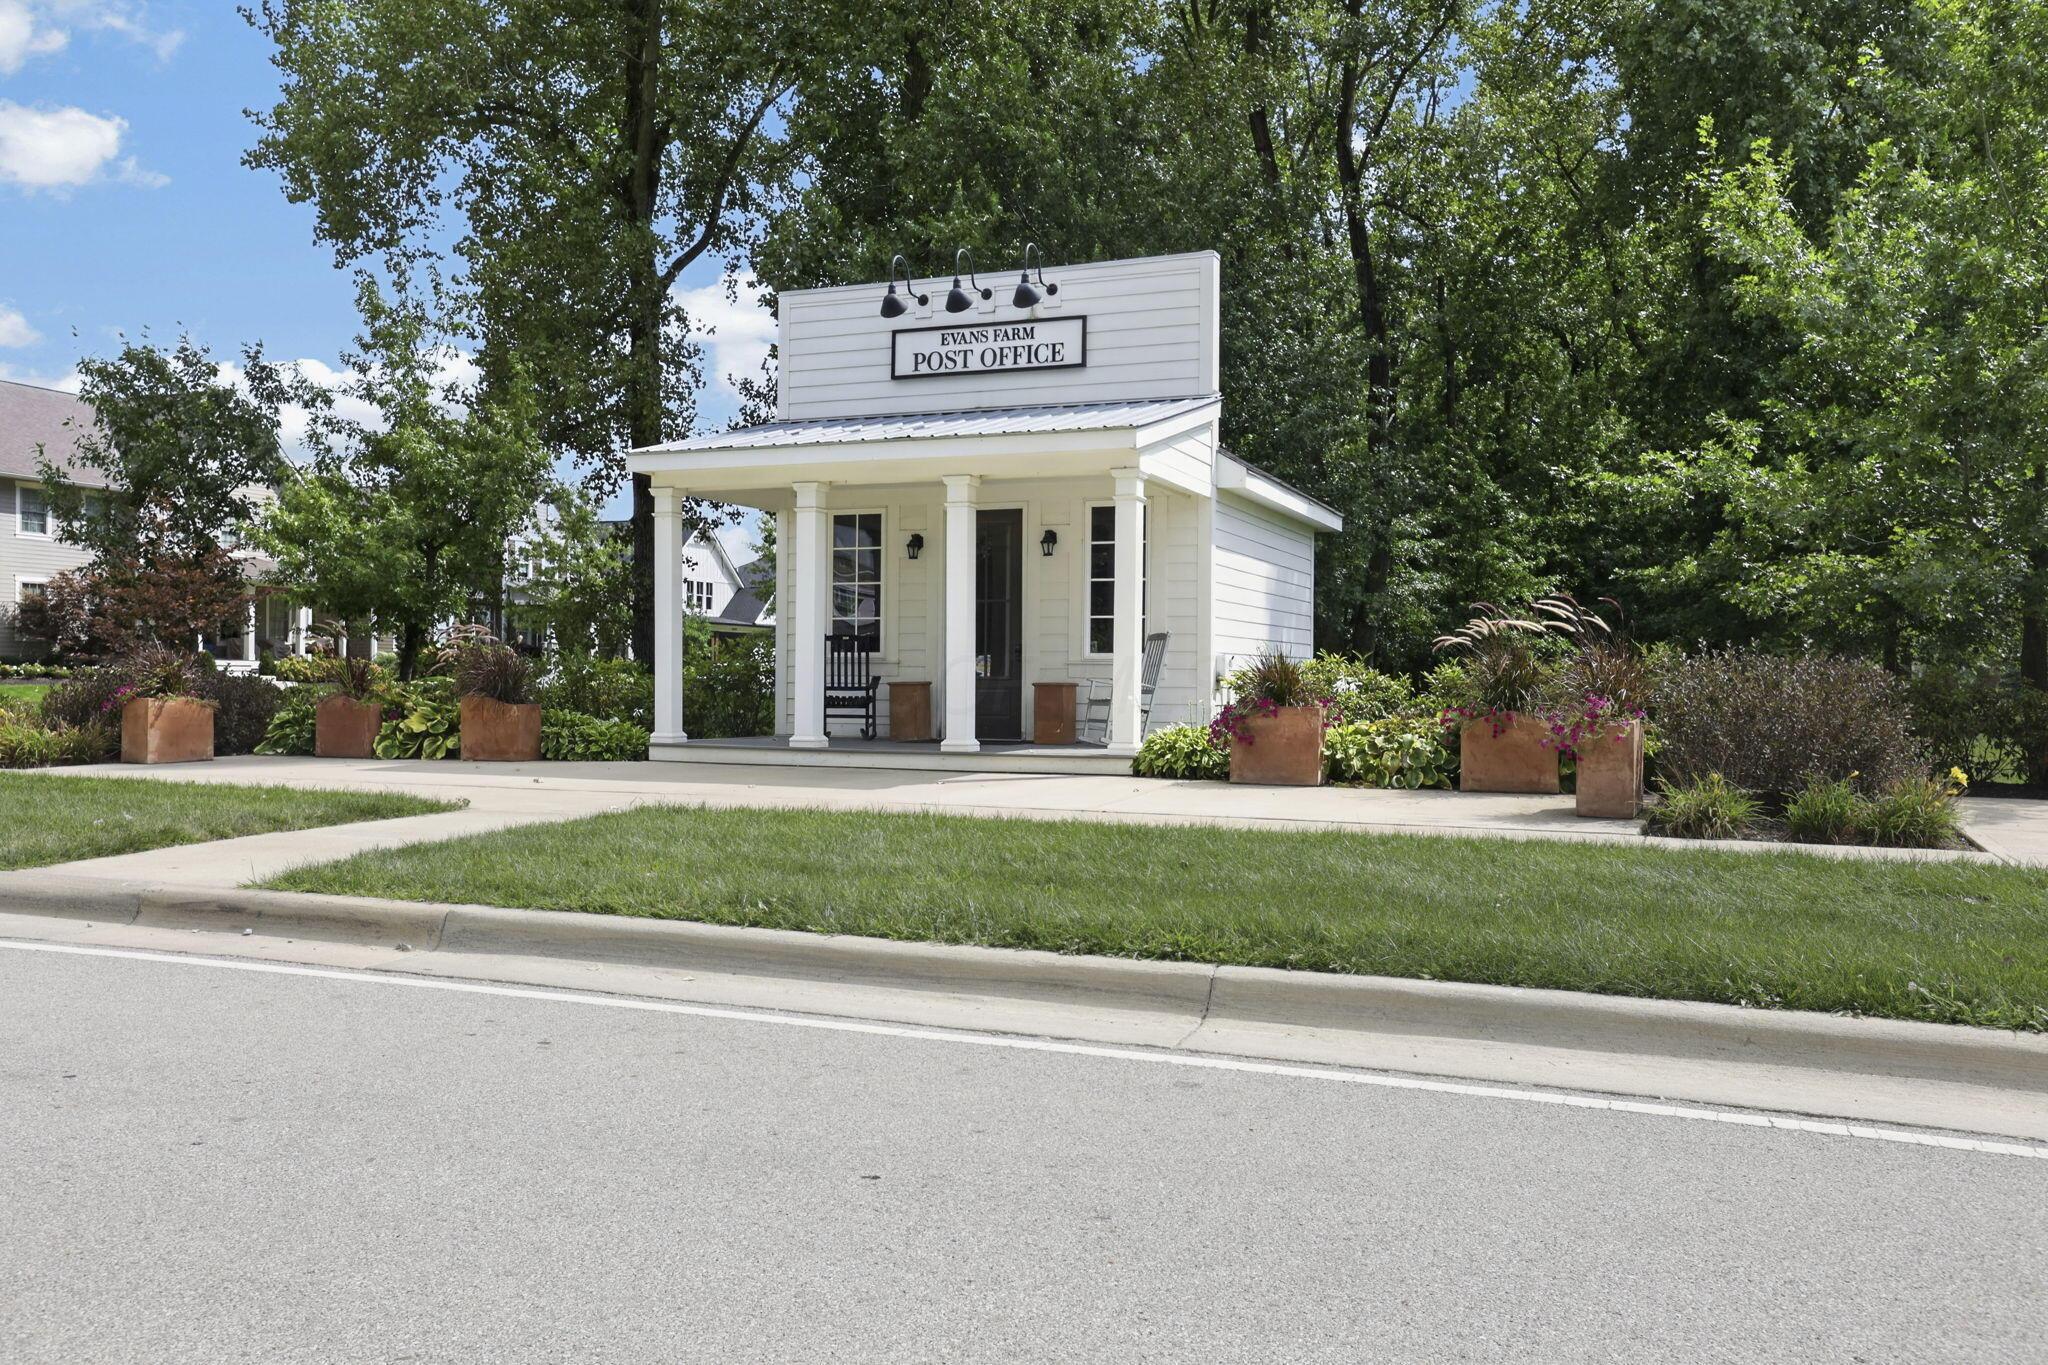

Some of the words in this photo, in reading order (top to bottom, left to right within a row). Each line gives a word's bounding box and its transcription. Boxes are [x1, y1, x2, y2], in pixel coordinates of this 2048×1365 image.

[940, 329, 989, 346] EVANS
[993, 326, 1036, 343] FARM
[911, 348, 974, 373] POST
[980, 342, 1065, 368] OFFICE
